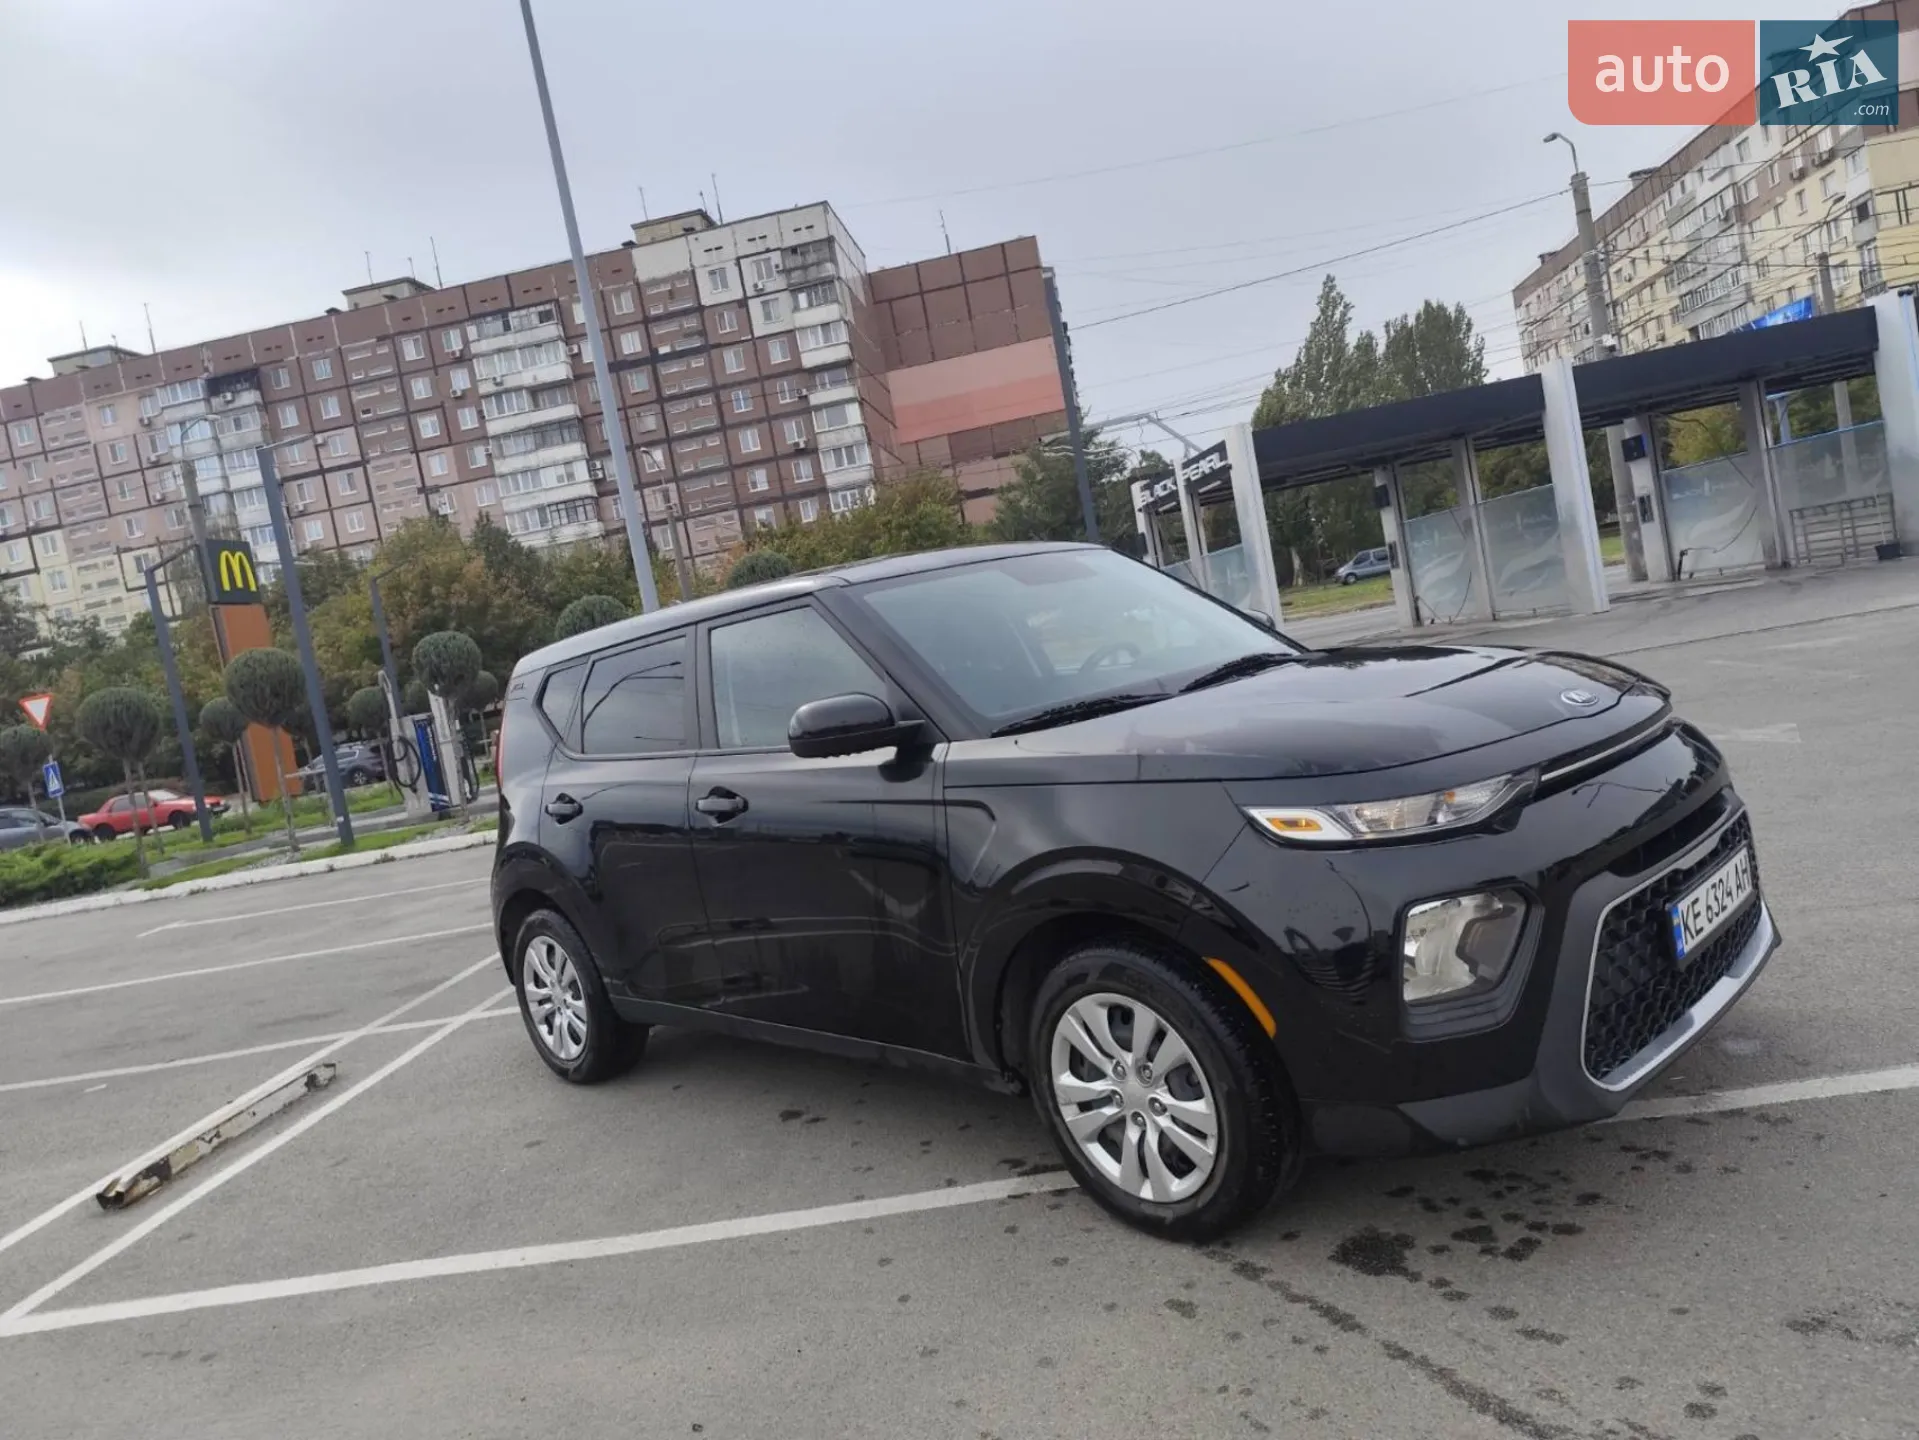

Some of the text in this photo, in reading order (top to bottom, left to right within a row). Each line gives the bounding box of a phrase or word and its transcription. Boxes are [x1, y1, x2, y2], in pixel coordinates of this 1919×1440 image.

[1181, 451, 1229, 481] PEARL
[1680, 854, 1750, 946] KE 6324 AH
